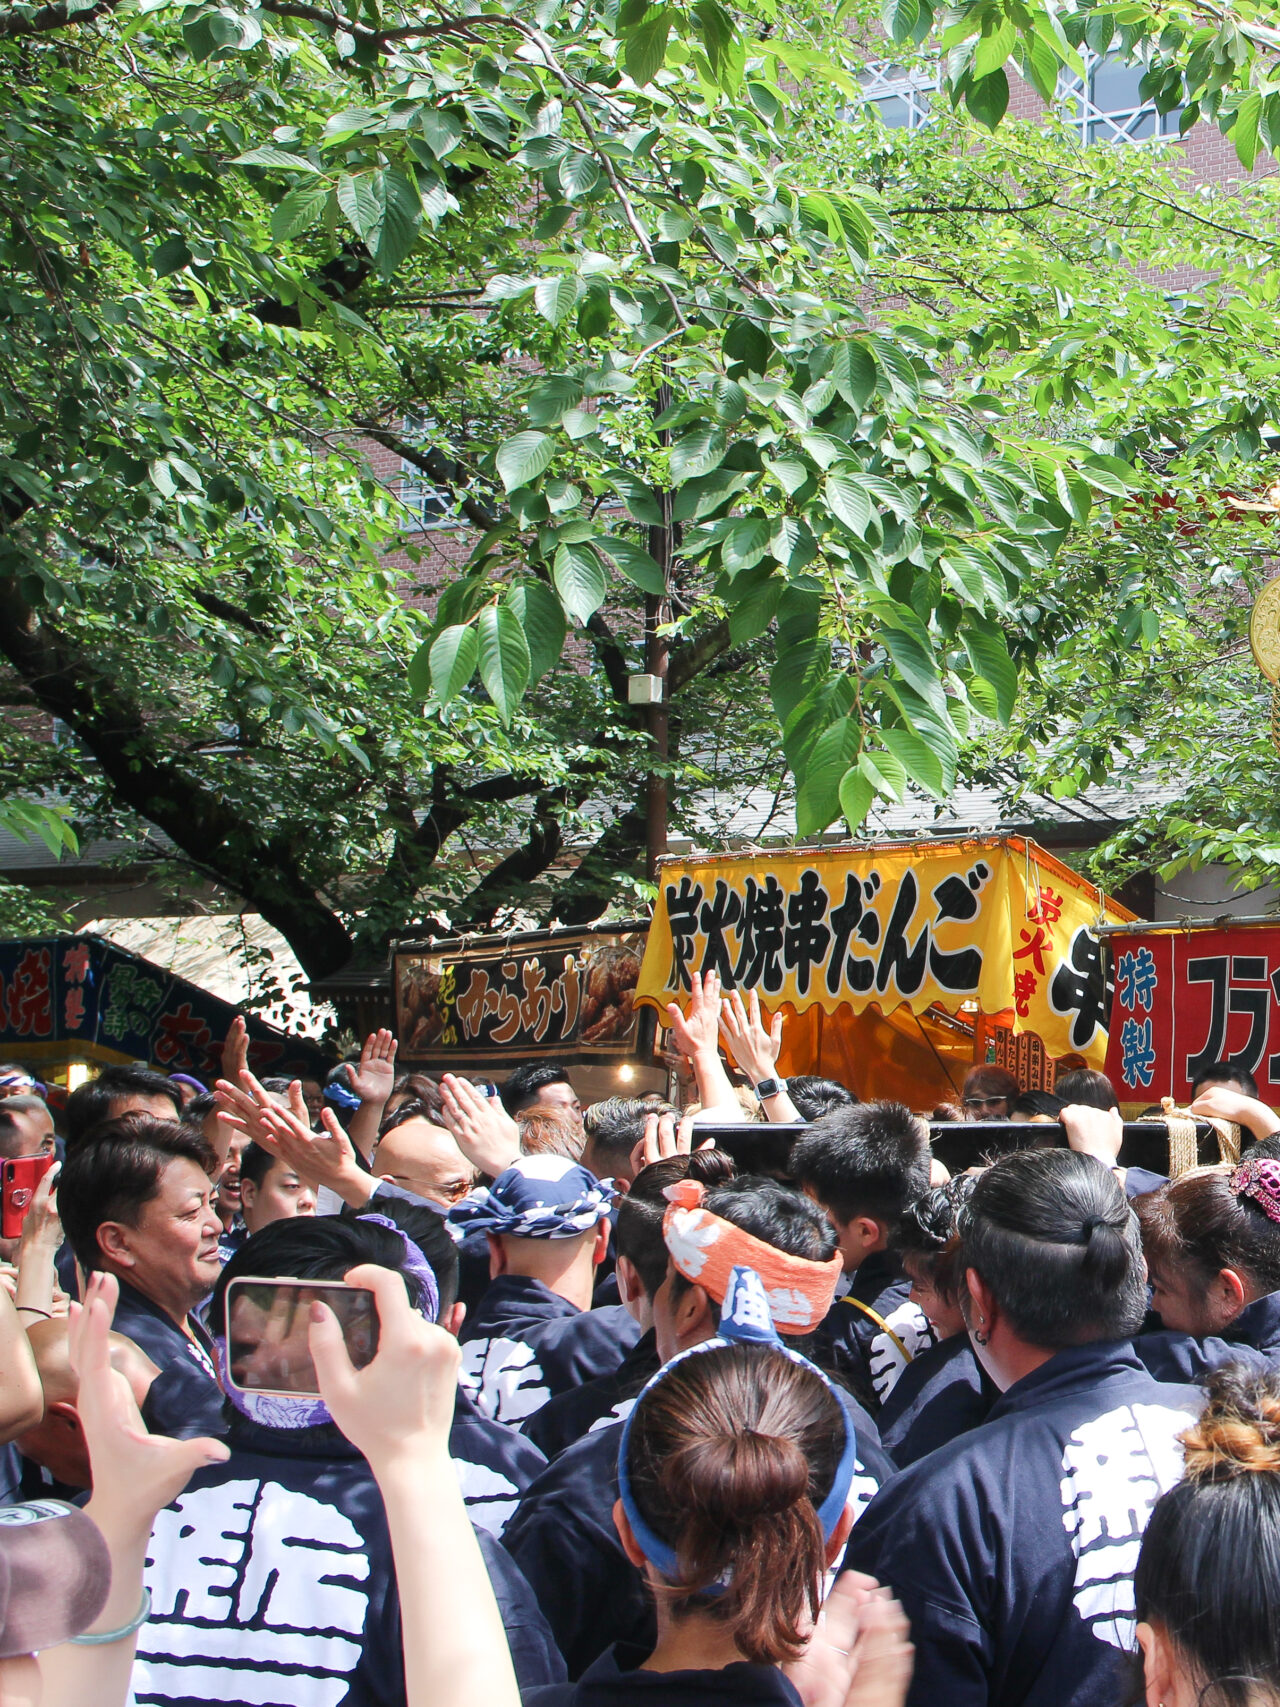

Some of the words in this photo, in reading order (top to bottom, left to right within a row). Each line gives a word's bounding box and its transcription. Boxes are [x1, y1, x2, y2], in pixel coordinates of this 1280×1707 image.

[663, 861, 994, 998] 炭火焼串だんご
[0, 946, 53, 1037] 焼
[456, 953, 593, 1044] からあげ
[1117, 946, 1158, 1090] 特製
